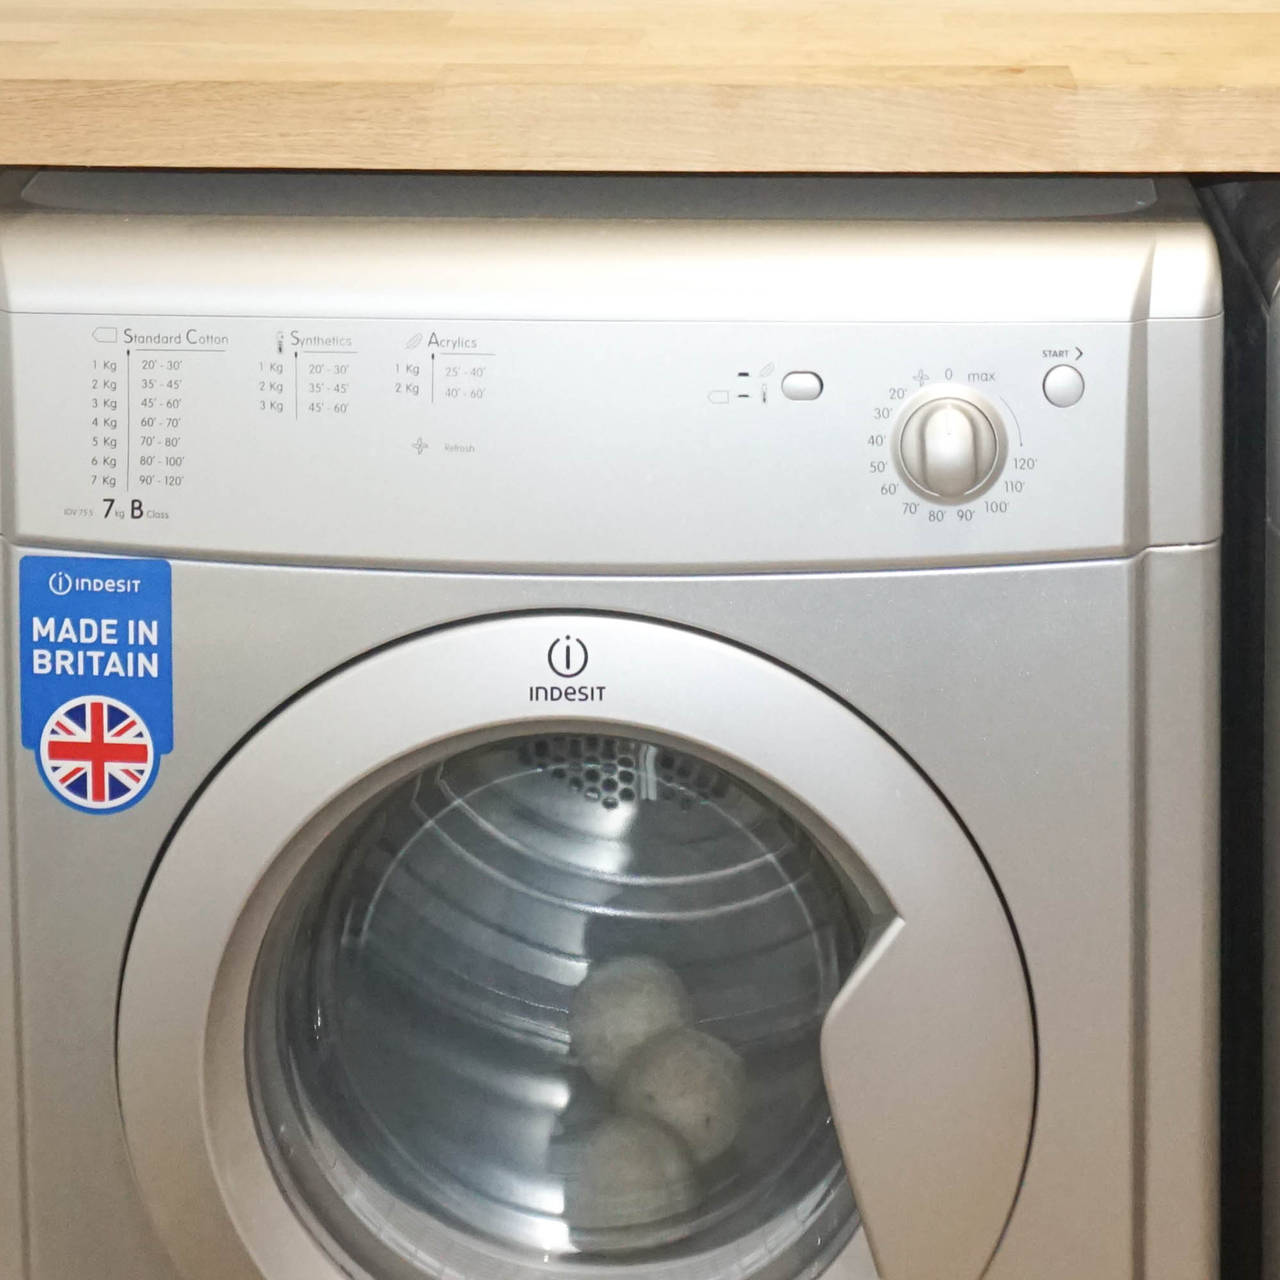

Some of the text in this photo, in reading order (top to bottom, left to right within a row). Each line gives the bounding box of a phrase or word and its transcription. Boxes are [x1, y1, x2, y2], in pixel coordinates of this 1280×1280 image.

[123, 328, 229, 344] Standard Cotton
[290, 330, 352, 348] Synthetics
[427, 332, 477, 349] Acrylics
[1042, 350, 1069, 358] START
[103, 360, 117, 372] Kg
[270, 363, 283, 374] Kg
[406, 364, 420, 376] Kg
[945, 369, 953, 380] 0
[968, 371, 996, 382] max
[92, 380, 98, 389] 2
[103, 380, 117, 391] Kg
[259, 381, 265, 391] 2
[270, 382, 283, 394] Kg
[395, 383, 401, 393] 2
[406, 384, 419, 395] Kg
[92, 399, 98, 408] 3
[103, 399, 117, 411] Kg
[260, 400, 265, 410] 3
[270, 401, 283, 413] Kg
[91, 417, 98, 427] 4
[103, 418, 117, 429] Kg
[92, 437, 98, 446] 5
[103, 437, 117, 449] Kg
[91, 456, 98, 465] 6
[103, 456, 117, 468] Kg
[91, 475, 97, 485] 7
[102, 476, 116, 488] Kg
[131, 499, 144, 519] B
[32, 617, 158, 646] MADE IN
[33, 649, 159, 678] BRITAIN
